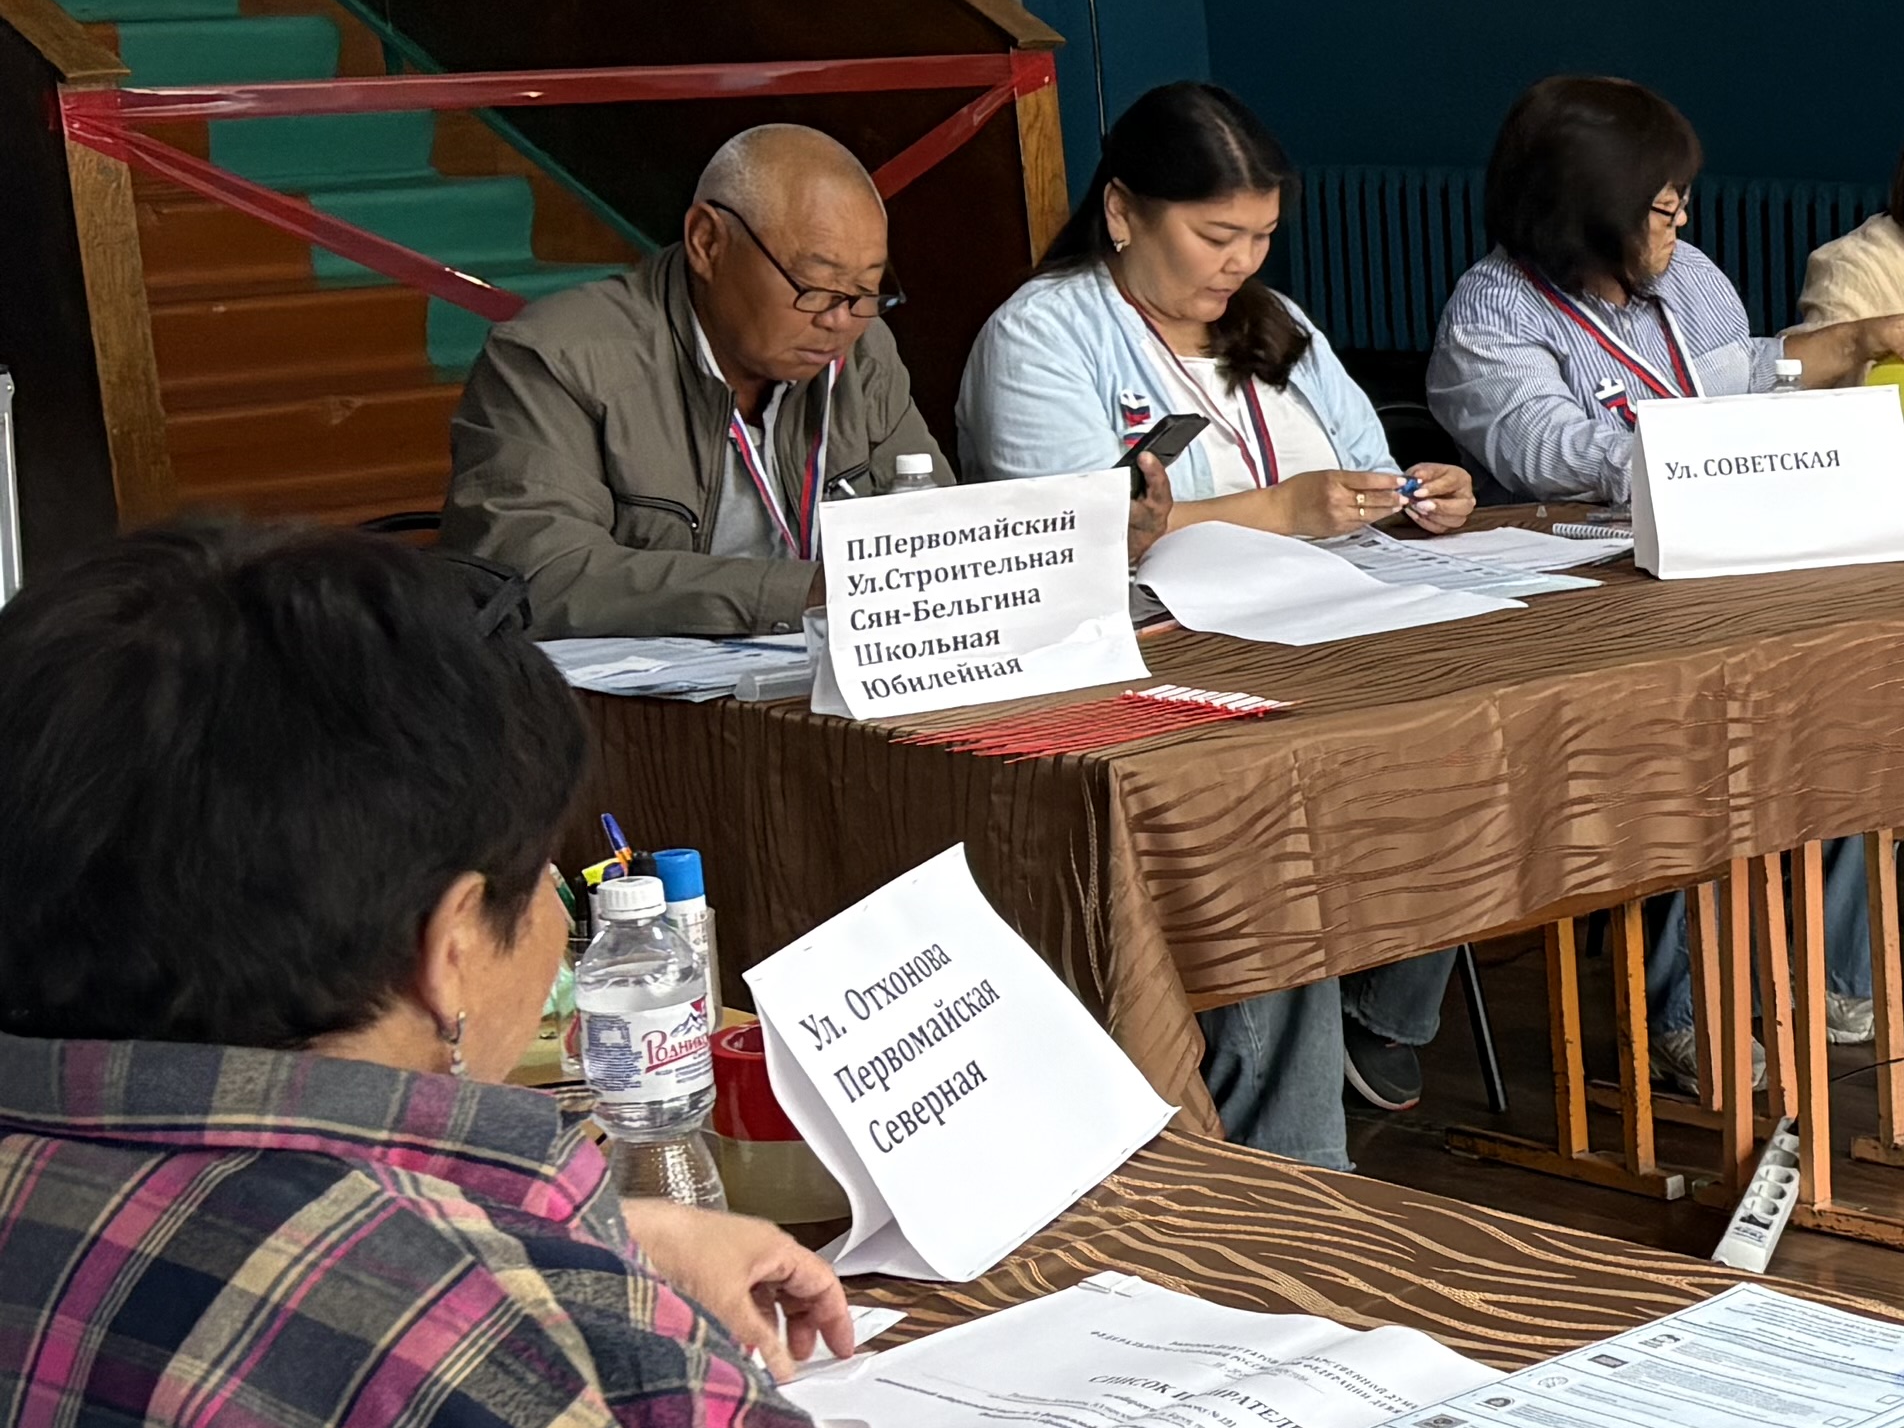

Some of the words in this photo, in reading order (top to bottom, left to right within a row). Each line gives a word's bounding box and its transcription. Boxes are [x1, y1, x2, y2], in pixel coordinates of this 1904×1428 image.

[1665, 461, 1698, 480] Ул.
[1703, 449, 1841, 477] СОВЕТСКАЯ
[847, 509, 1077, 562] П.Первомайский
[847, 547, 1076, 597] Ул.Строительная
[850, 586, 1042, 632] Сян-Бельгина
[854, 628, 1001, 668] Школьная
[860, 657, 1024, 701] Юбилейная
[798, 1010, 849, 1052] Ул.
[843, 942, 953, 1021] Отхонова
[833, 975, 1001, 1104] Первомайская
[868, 1056, 989, 1155] Северная
[1088, 1374, 1171, 1401] СПИСОК
